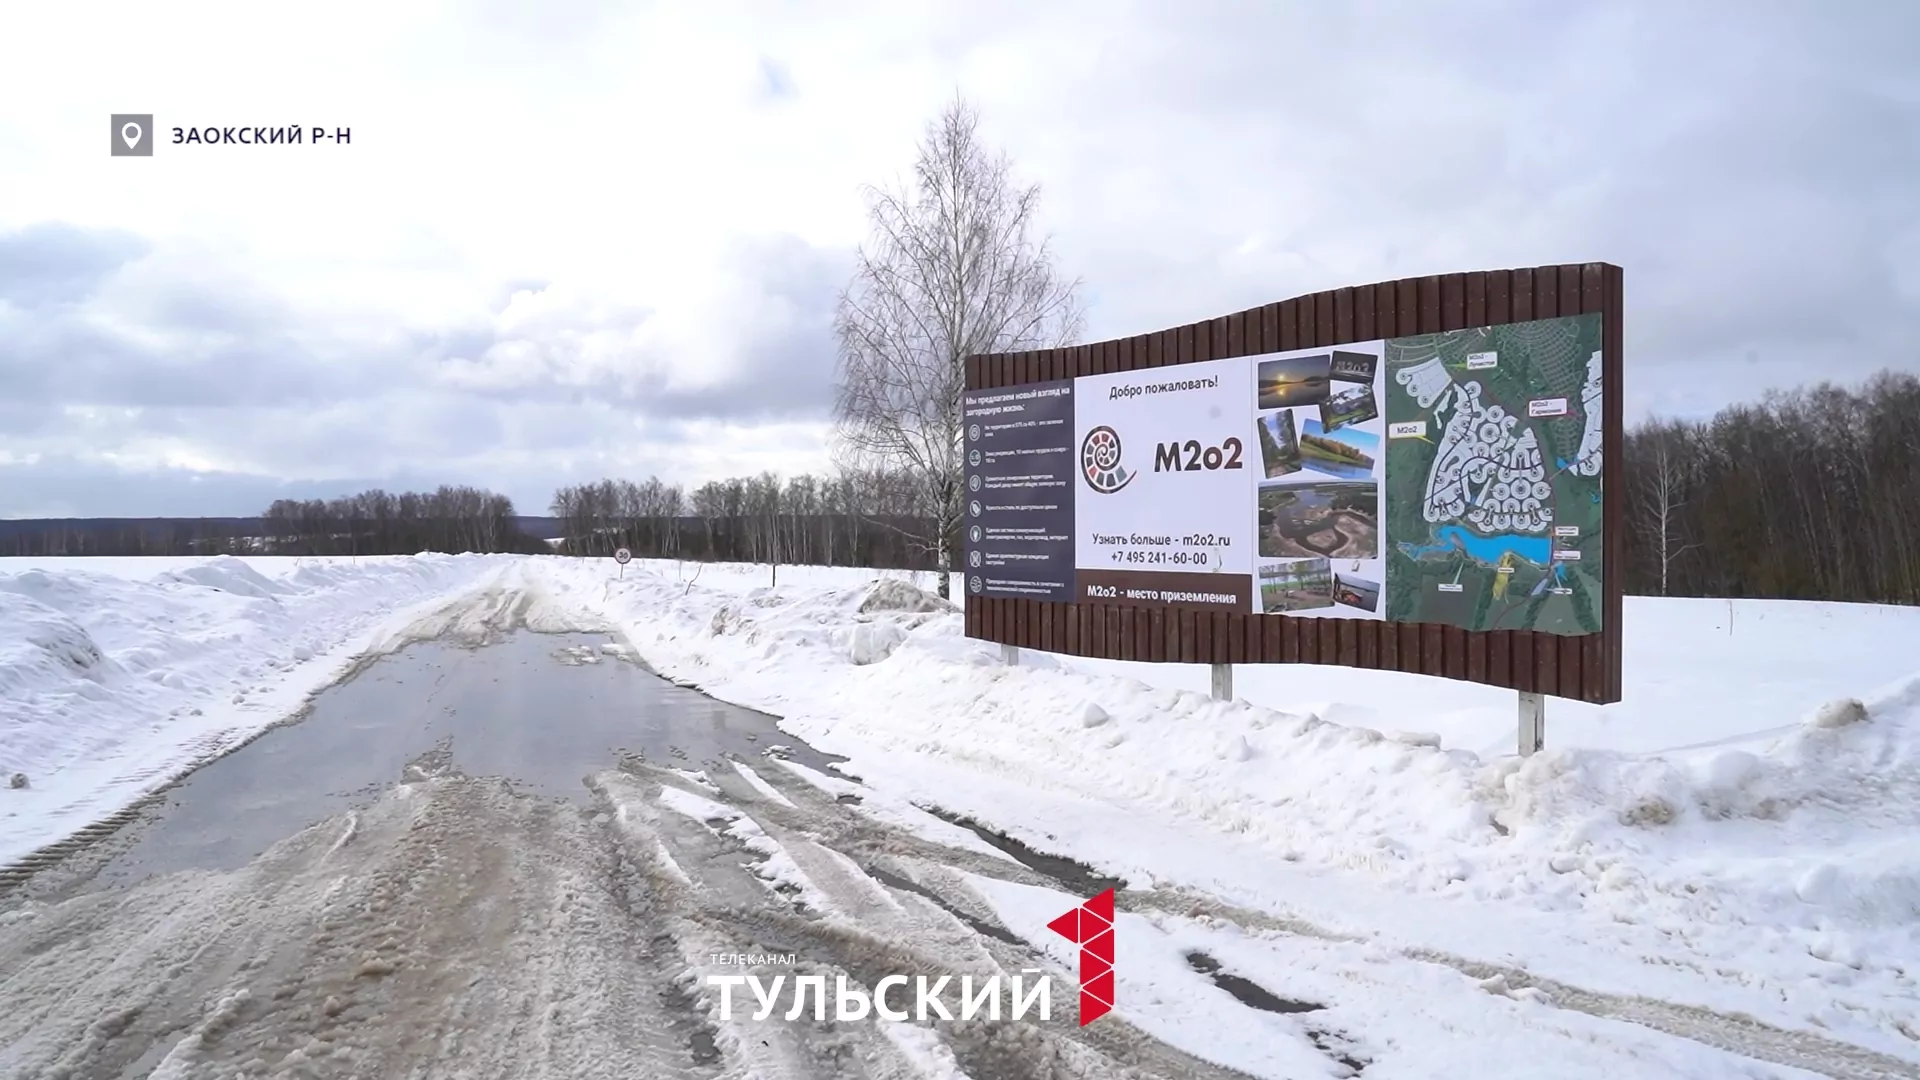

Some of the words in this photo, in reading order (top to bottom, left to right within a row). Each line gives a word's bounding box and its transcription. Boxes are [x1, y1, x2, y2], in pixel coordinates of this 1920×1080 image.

[1110, 386, 1142, 400] Добро
[1145, 375, 1218, 395] пожаловать!
[1016, 390, 1036, 400] новый
[966, 407, 1001, 416] загородную
[1155, 437, 1243, 472] M2o2
[1092, 533, 1128, 545] Узнать
[1130, 534, 1171, 545] больше
[1183, 534, 1230, 546] m2o2.ru
[1111, 551, 1123, 562] +7
[1126, 552, 1145, 563] 495
[1148, 552, 1207, 565] 241-60-00
[1127, 590, 1158, 601] место
[1161, 590, 1236, 604] приземления
